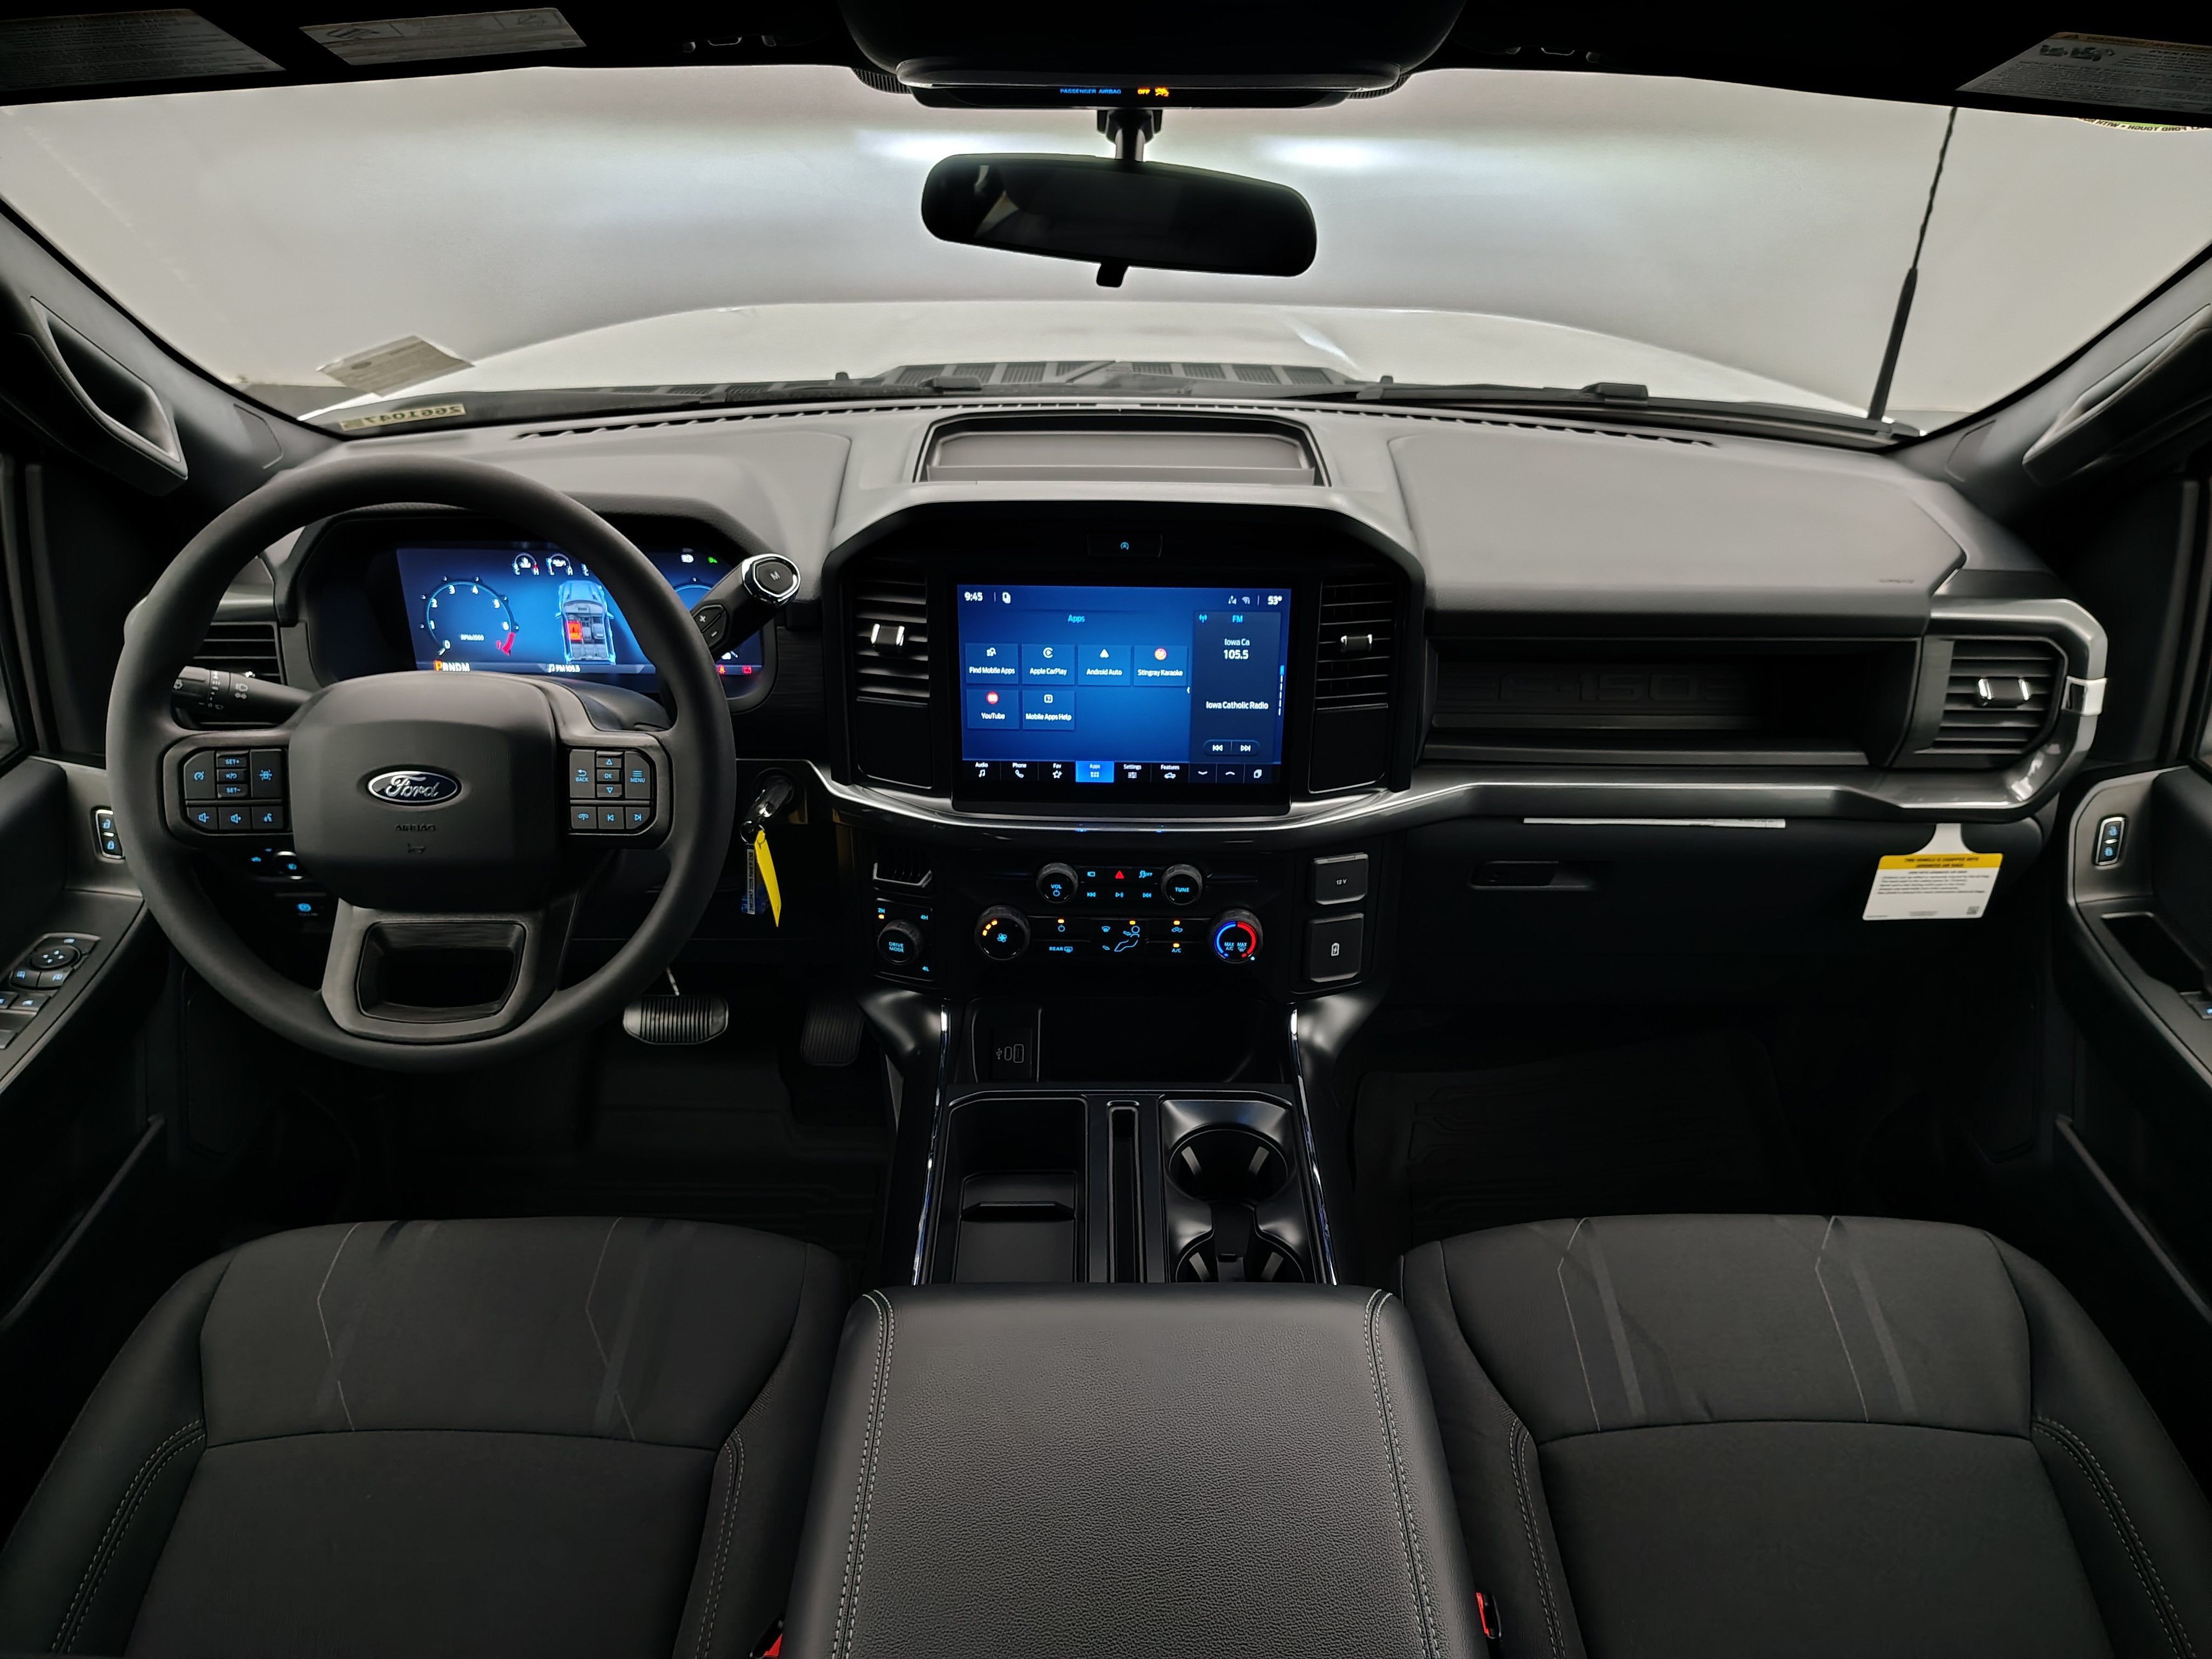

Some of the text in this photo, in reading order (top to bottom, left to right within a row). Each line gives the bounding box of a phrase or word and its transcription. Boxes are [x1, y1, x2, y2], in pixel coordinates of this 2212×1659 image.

[770, 571, 780, 581] M
[449, 584, 455, 595] 3
[472, 585, 478, 595] 4
[965, 591, 983, 602] 9:45
[431, 598, 438, 608] 2
[1068, 614, 1085, 623] Apps
[1232, 615, 1243, 623] FM
[429, 620, 435, 630] 1
[443, 639, 451, 649] 0
[1223, 649, 1249, 659] 105.5
[1001, 667, 1015, 675] Apps
[1137, 669, 1160, 677] Stingray
[1206, 701, 1222, 709] Iowa
[1250, 702, 1269, 710] Radio
[1044, 713, 1058, 721] Apps
[1058, 713, 1071, 721] Help
[386, 774, 440, 798] Ford
